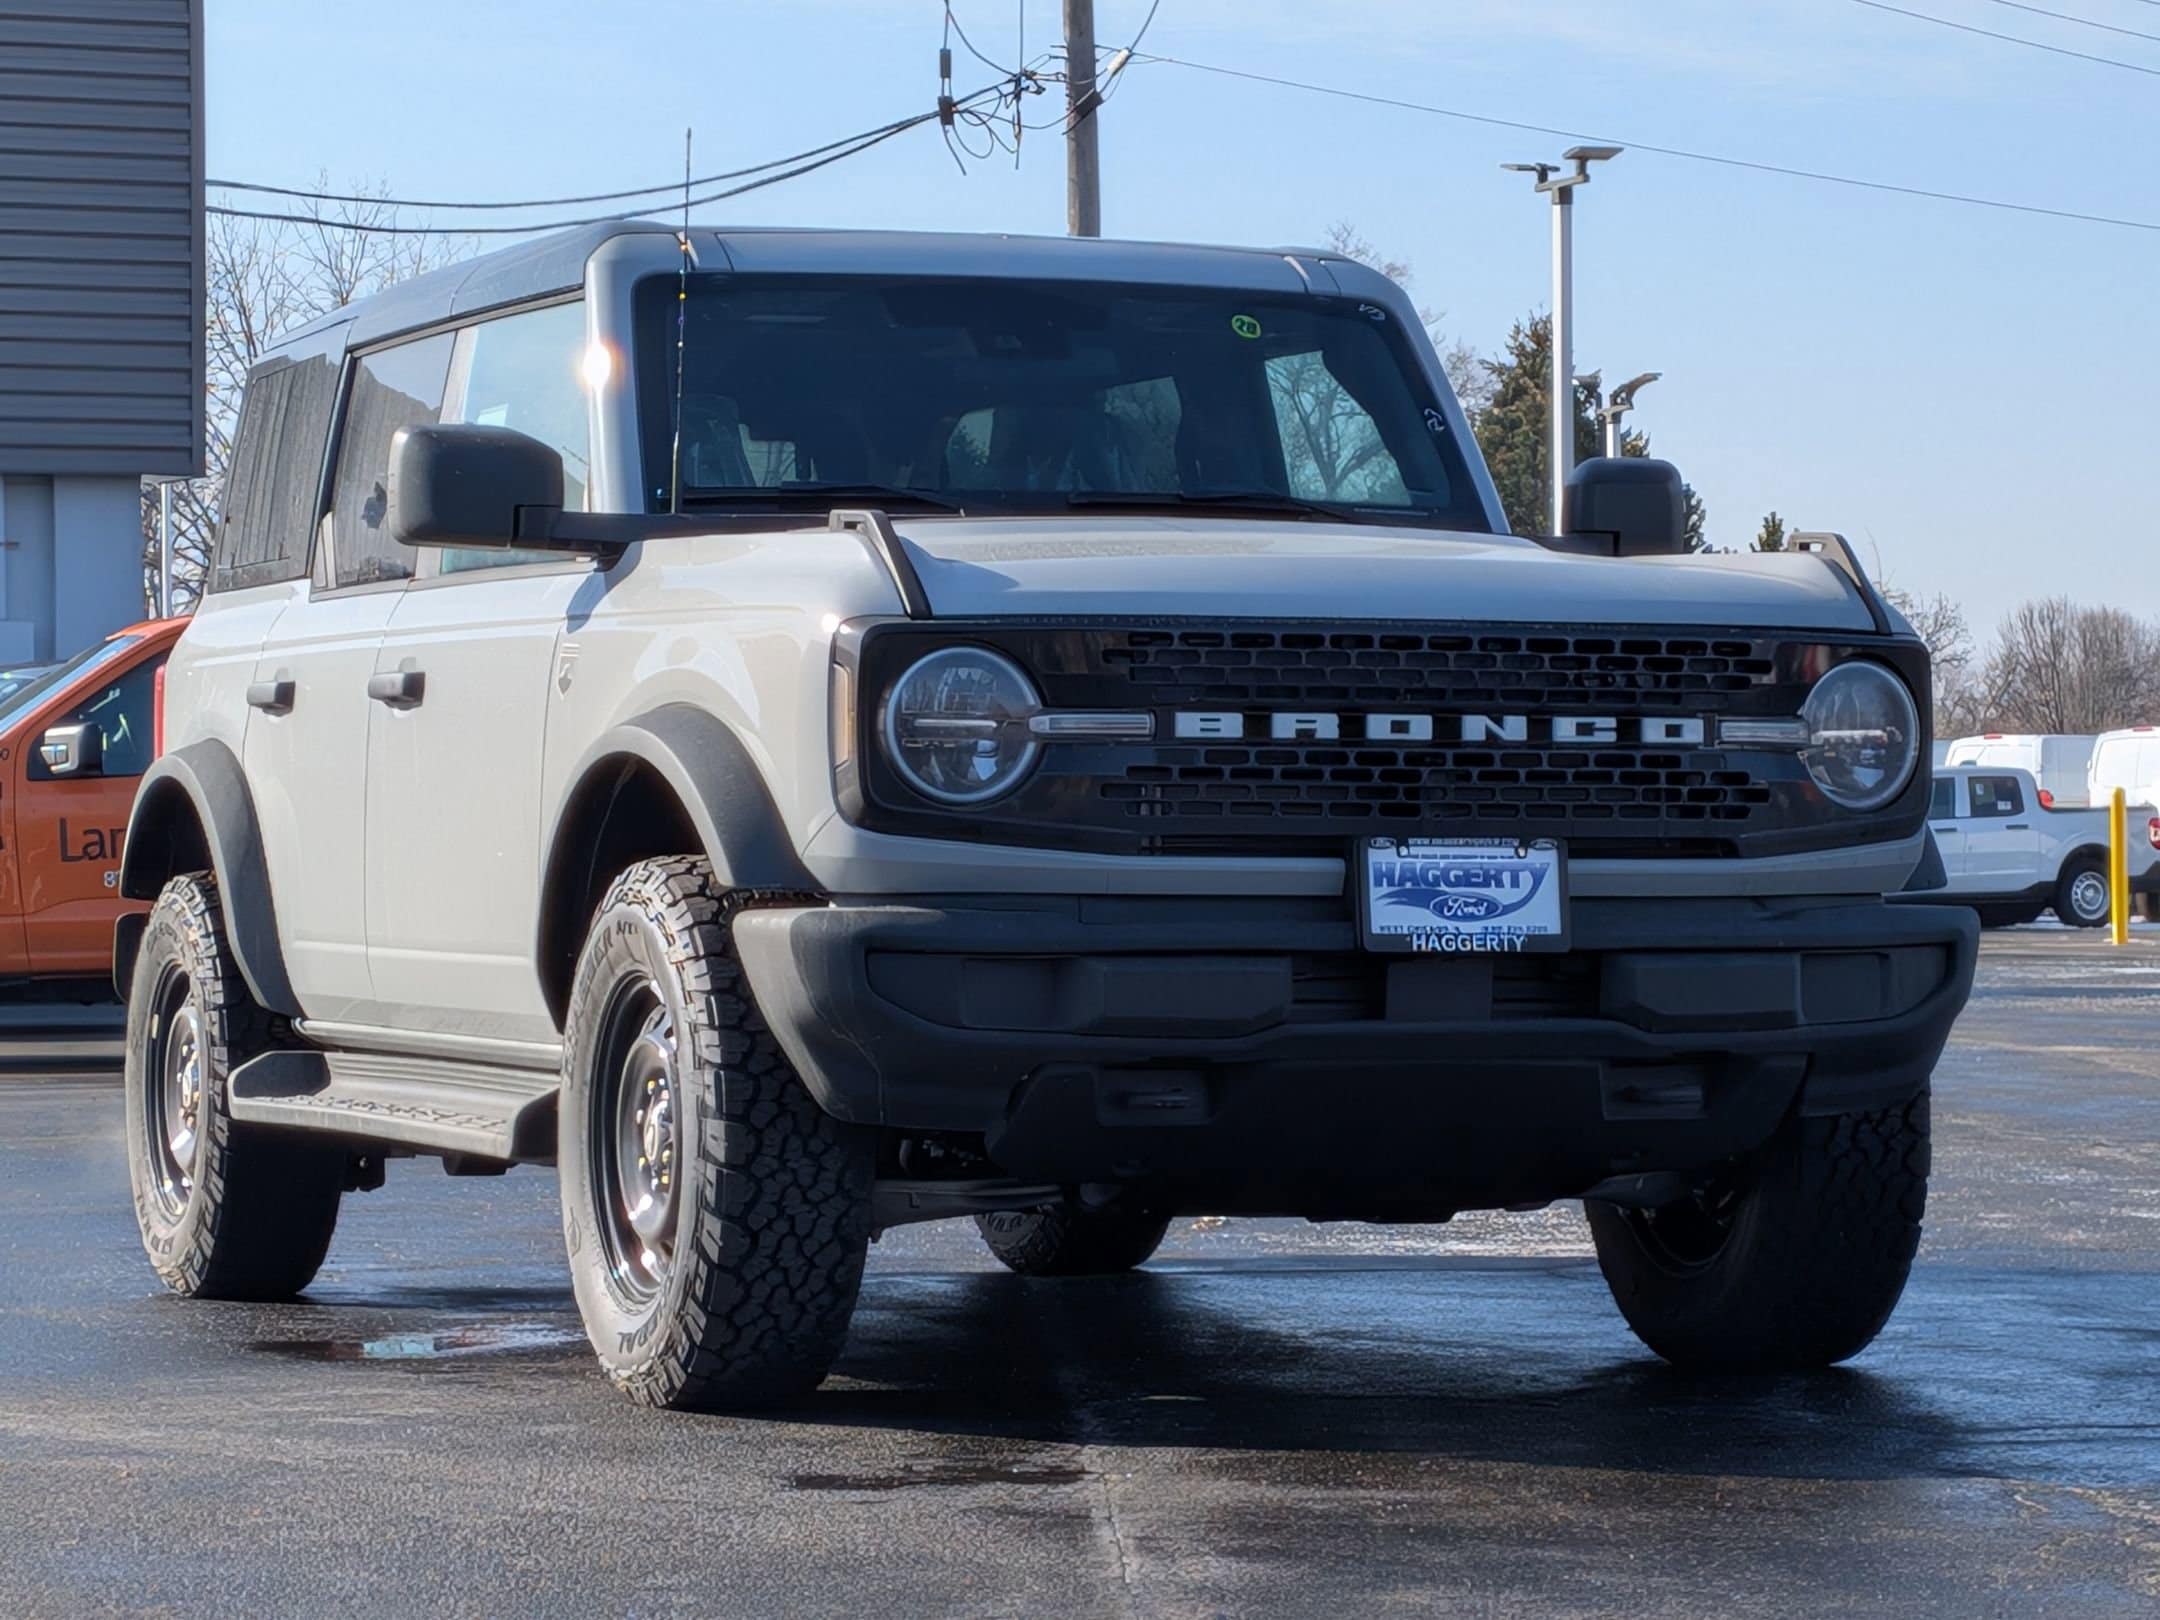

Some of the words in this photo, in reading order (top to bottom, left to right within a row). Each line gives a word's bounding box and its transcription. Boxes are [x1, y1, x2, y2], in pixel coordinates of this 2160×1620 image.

[1174, 711, 1705, 744] BRONCO
[1372, 861, 1550, 890] HAGGERTY
[1443, 896, 1488, 917] Ford
[1411, 933, 1527, 952] HAGGERTY
